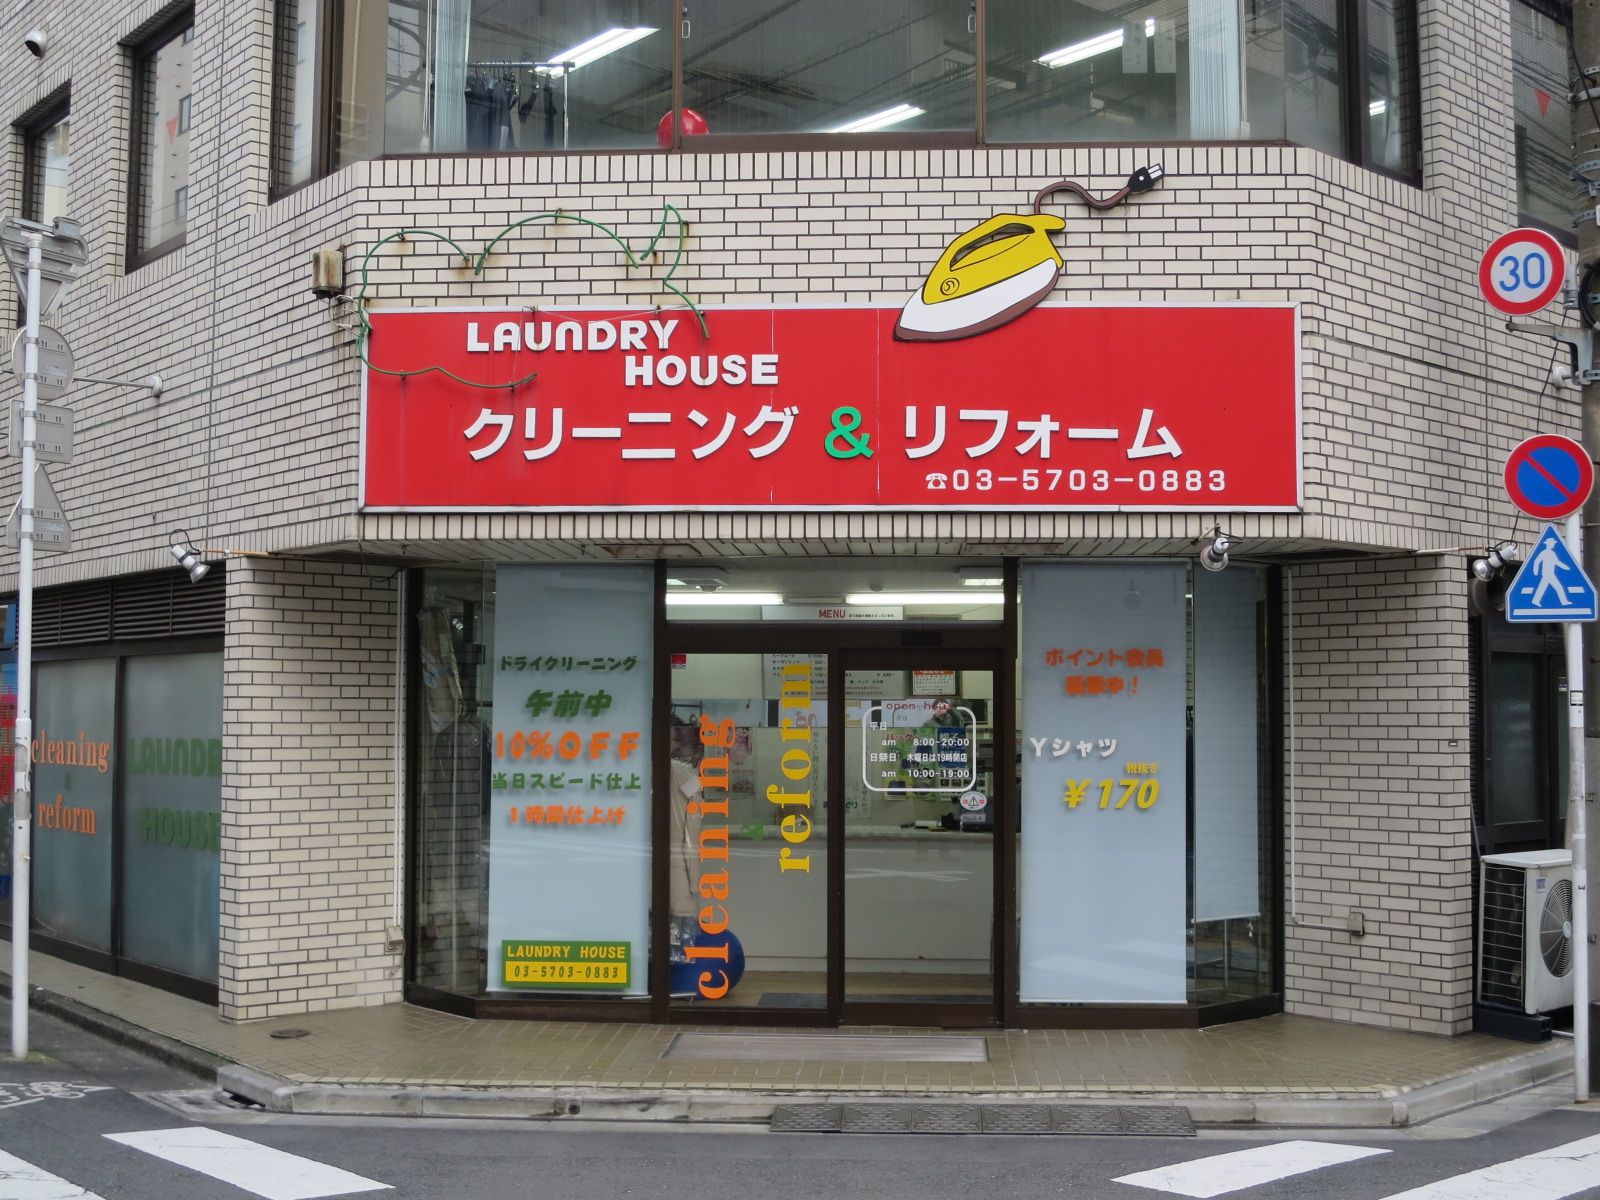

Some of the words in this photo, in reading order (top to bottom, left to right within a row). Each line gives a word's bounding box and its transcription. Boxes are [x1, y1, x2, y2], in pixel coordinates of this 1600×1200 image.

[1499, 252, 1546, 292] 30
[466, 319, 679, 352] LAUNDRY
[624, 353, 780, 386] HOUSE
[463, 404, 800, 460] クリーニング
[824, 405, 875, 460] &
[905, 405, 1184, 460] リフォーム
[818, 609, 846, 619] MENU
[501, 655, 638, 672] ドライクリーニング
[525, 689, 613, 718] 午前中
[886, 702, 916, 711] open
[869, 721, 887, 731] 平日
[31, 729, 111, 773] cleaning
[870, 753, 897, 763] 日祭日
[1029, 737, 1118, 758] Yシャツ
[766, 662, 812, 873] reform
[492, 772, 642, 790] 当日スピード仕上
[38, 794, 97, 836] reform
[683, 713, 736, 1000] cleaning
[507, 945, 571, 958] LAUNDRY
[580, 946, 626, 959] HOUSE
[514, 965, 619, 978] 03-5703-0883
